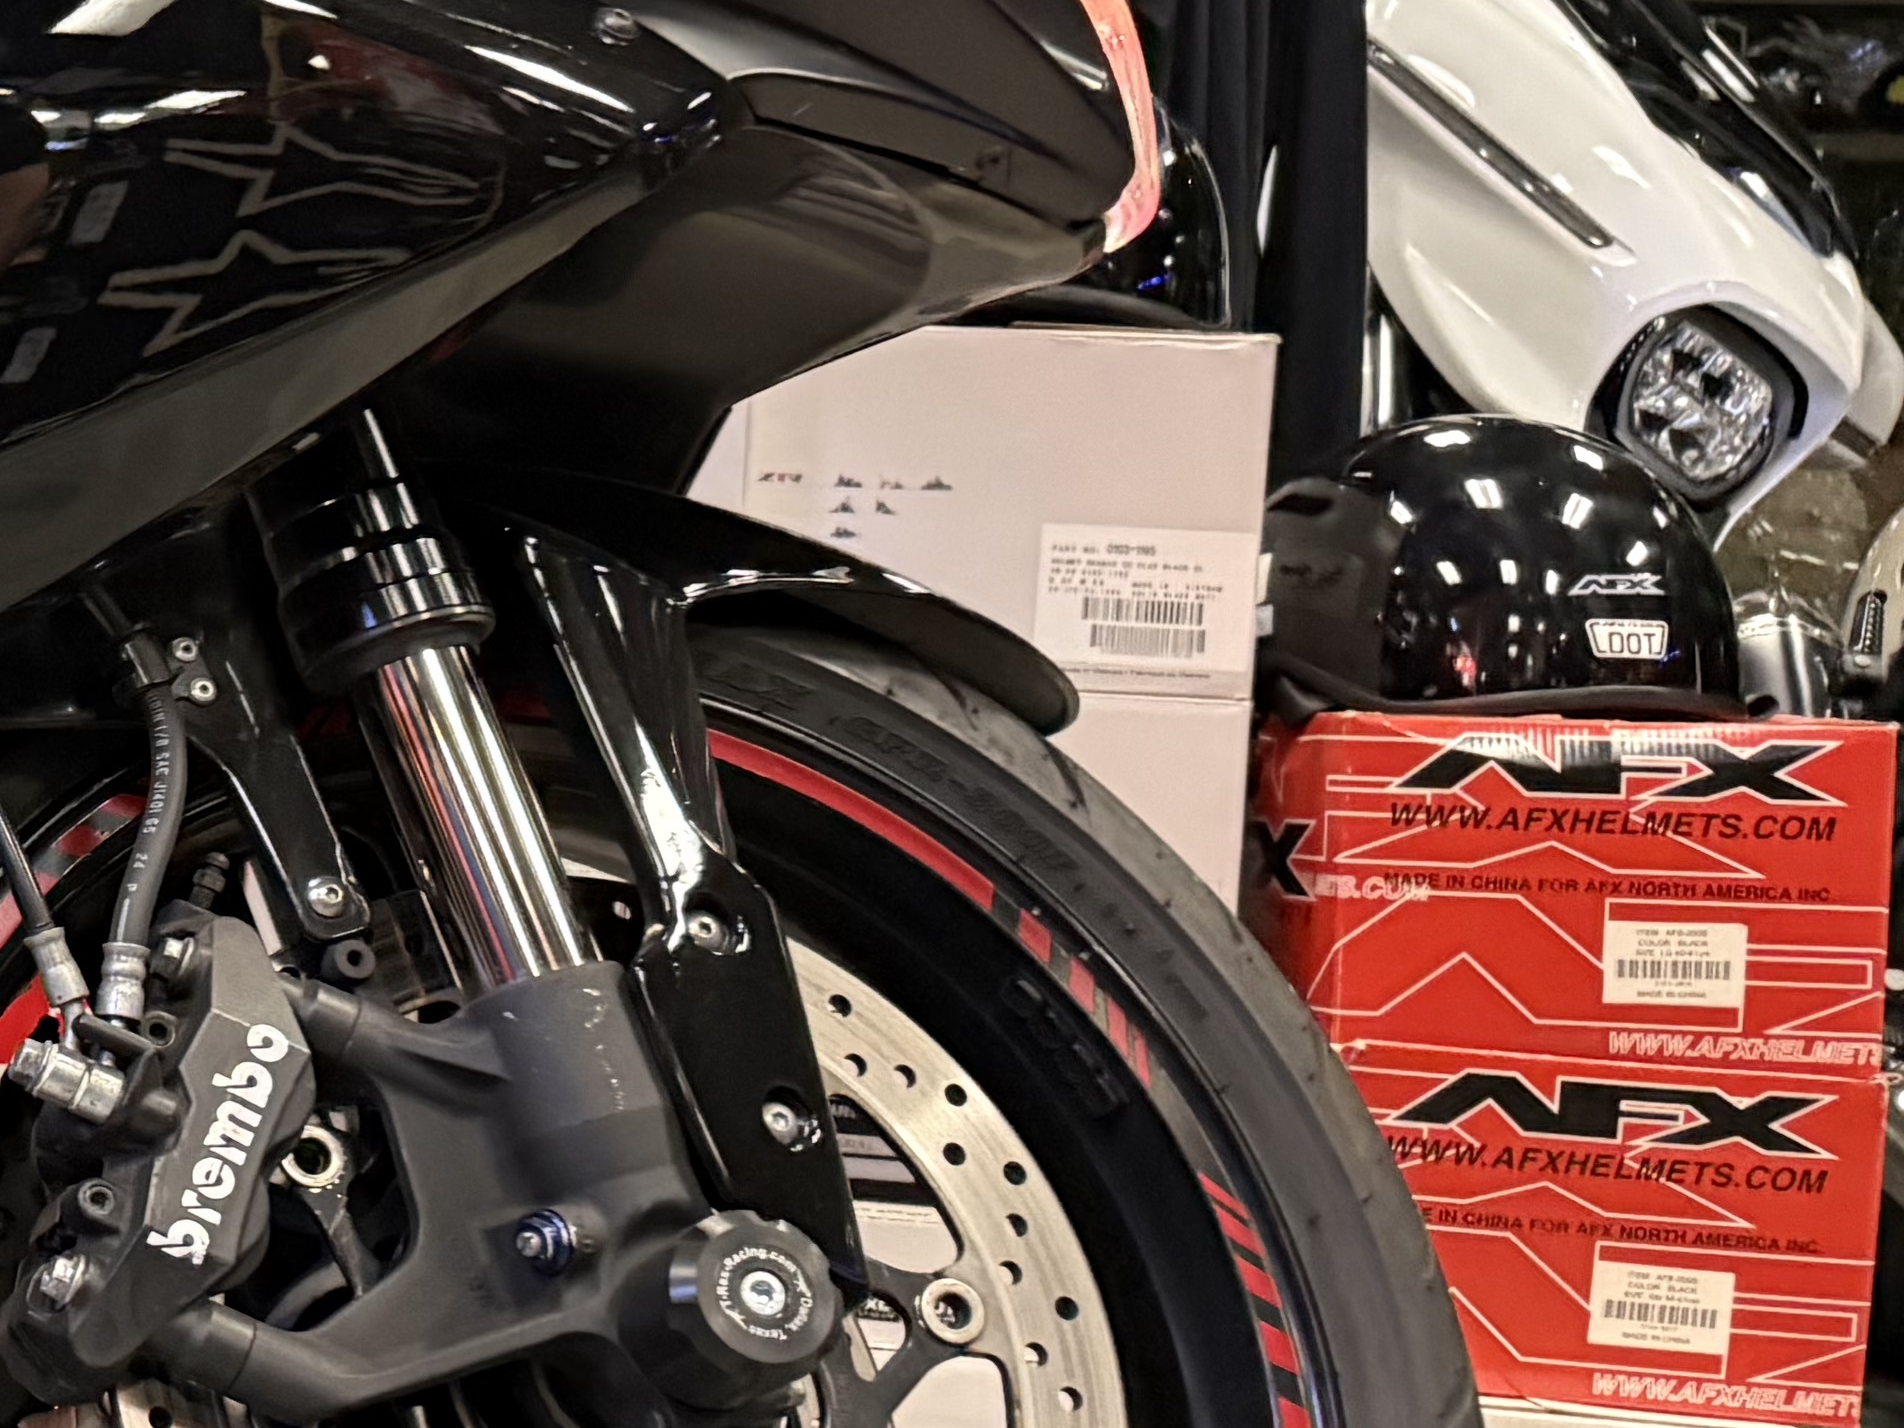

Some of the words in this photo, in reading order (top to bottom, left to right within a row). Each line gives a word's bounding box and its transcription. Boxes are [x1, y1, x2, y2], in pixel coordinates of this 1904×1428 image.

[1568, 572, 1665, 596] AFX
[1608, 631, 1656, 655] DOT
[155, 752, 170, 776] SAE
[1392, 731, 1848, 808] AFX
[1391, 803, 1837, 844] WWW.AFXHELMETS.COM
[1385, 873, 1440, 889] MADE
[1446, 874, 1467, 890] IN
[1473, 875, 1531, 892] CHINA
[1538, 878, 1578, 893] FOR
[1584, 879, 1623, 895] AFX
[1629, 881, 1697, 899] NORTH
[1702, 884, 1792, 902] AMERICA
[1797, 886, 1831, 903] INC
[1386, 1068, 1840, 1160] AFX
[146, 1023, 289, 1266] brembo
[1388, 1134, 1829, 1195] WWW.AFXHELMETS.COM
[1439, 1209, 1459, 1224] IN
[1462, 1211, 1523, 1231] CHINA
[1530, 1218, 1570, 1234] FOR
[1621, 1225, 1689, 1245] NORTH
[1692, 1231, 1781, 1252] AMERICA
